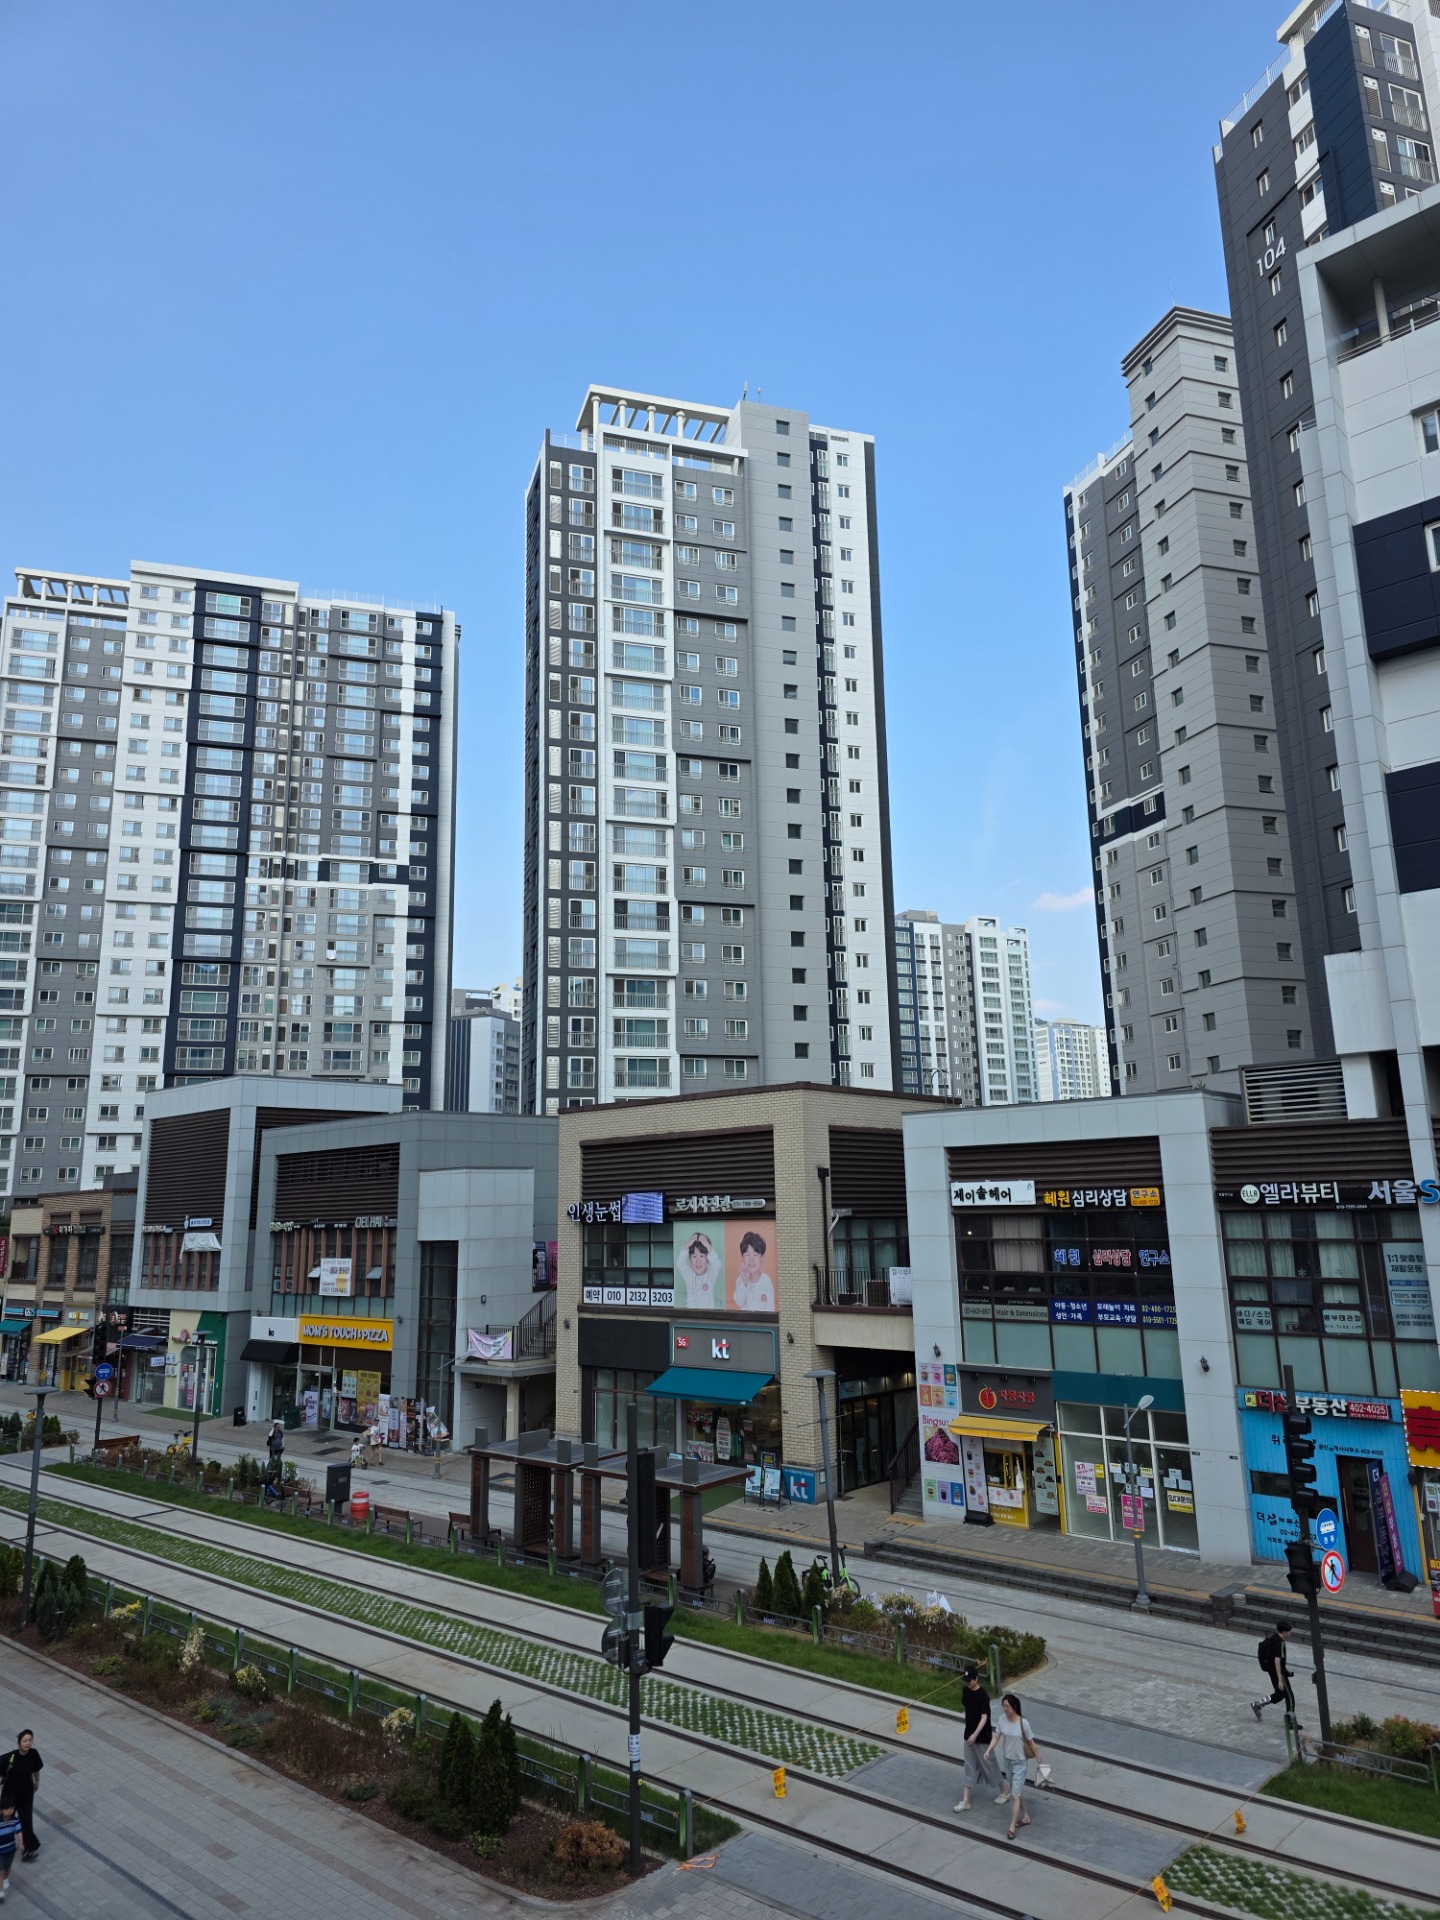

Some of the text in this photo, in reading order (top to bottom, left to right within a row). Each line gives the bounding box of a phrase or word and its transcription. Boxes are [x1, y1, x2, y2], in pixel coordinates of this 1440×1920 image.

[1256, 236, 1287, 277] 104
[1043, 1189, 1158, 1208] 혜원 심리상담 연구소
[1242, 1189, 1259, 1198] ELLA
[1260, 1181, 1340, 1205] 엘라뷰티
[1367, 1179, 1418, 1205] 서울
[567, 1200, 621, 1223] 인생눈썹
[675, 1195, 731, 1213] 로제사진관
[1054, 1249, 1170, 1267] 혜원 심리상담 연구소
[585, 1289, 601, 1302] 예약
[607, 1290, 673, 1303] 010 2132 3203
[1016, 1309, 1048, 1318] Extensions
[1097, 1303, 1136, 1312] 모래놀이 치료
[303, 1324, 328, 1338] MOM'S
[329, 1326, 356, 1340] TOUCH
[362, 1328, 389, 1342] PIZZA
[711, 1337, 730, 1359] kt
[1295, 1395, 1348, 1418] 부동산
[791, 1476, 809, 1500] kt
